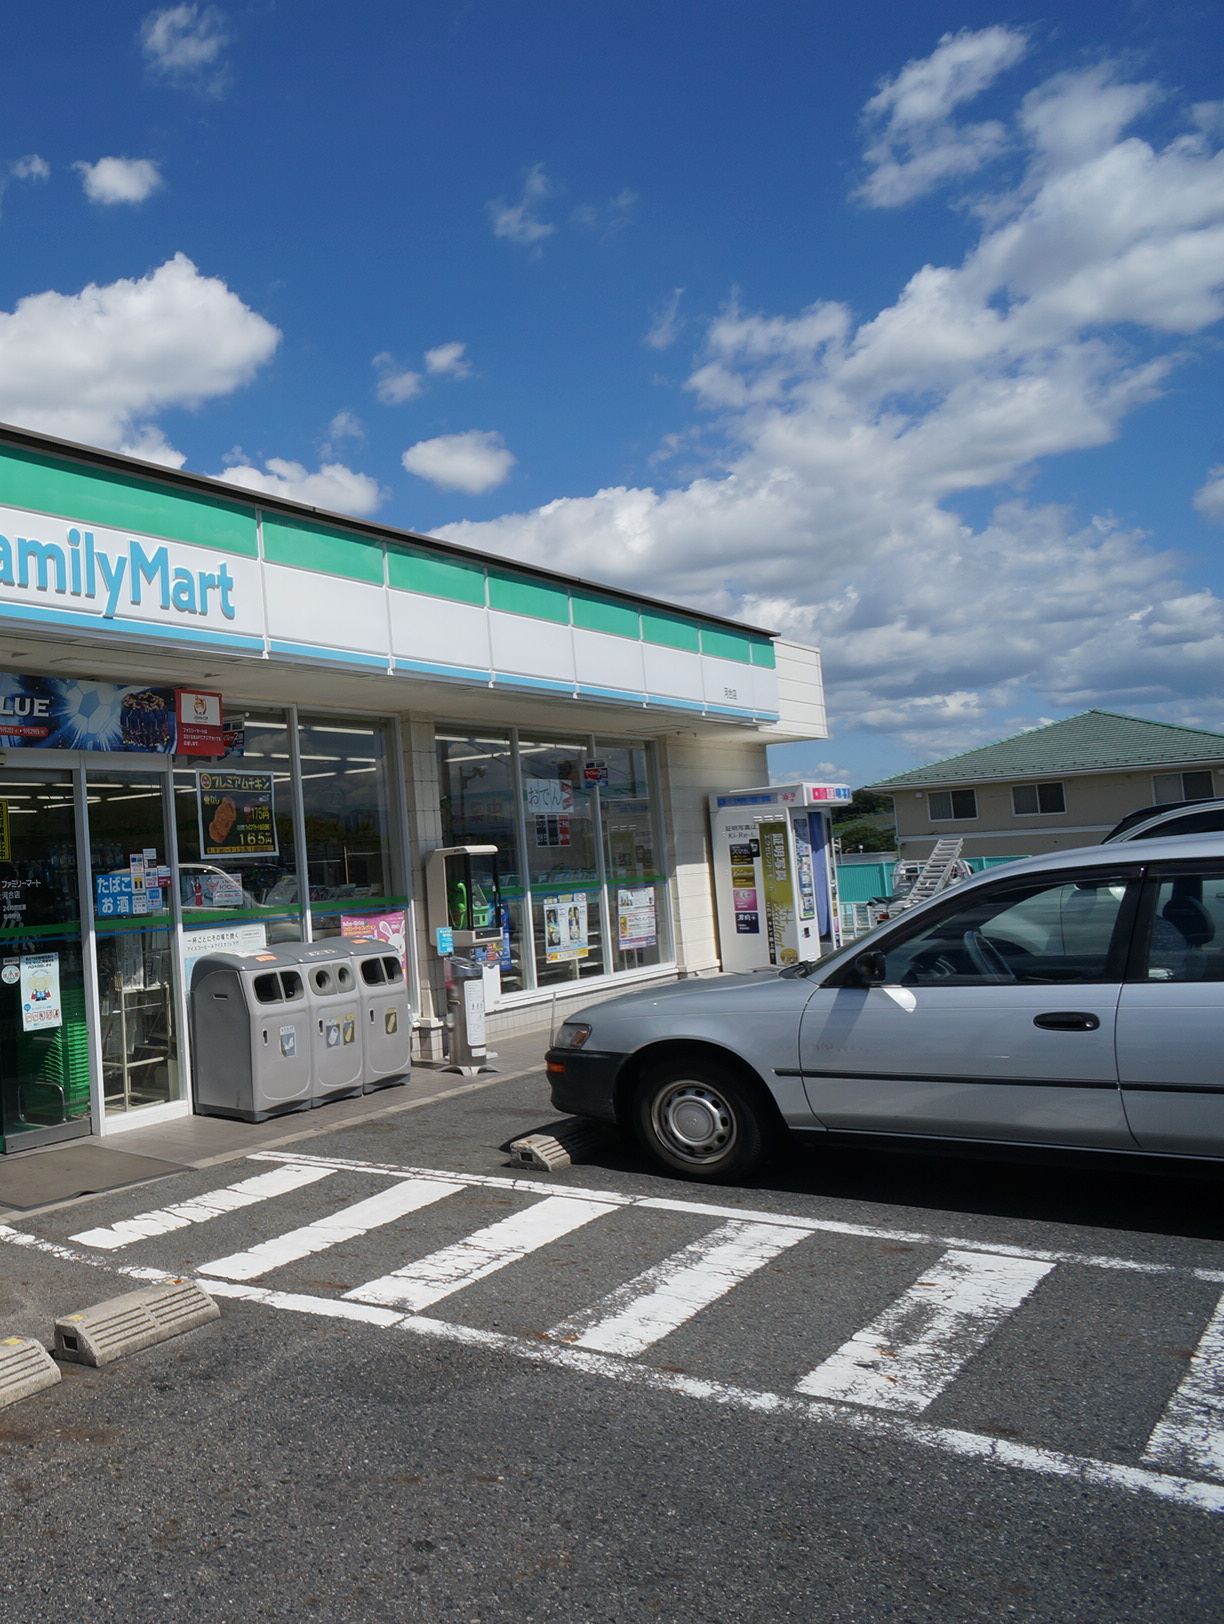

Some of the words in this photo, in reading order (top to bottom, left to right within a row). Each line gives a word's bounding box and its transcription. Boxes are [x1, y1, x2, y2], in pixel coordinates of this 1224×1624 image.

[528, 787, 562, 806] おでん
[772, 833, 787, 882] 証明写真
[1, 879, 42, 889] ファミリーマート
[97, 877, 131, 893] たばこ
[102, 896, 129, 913] お酒
